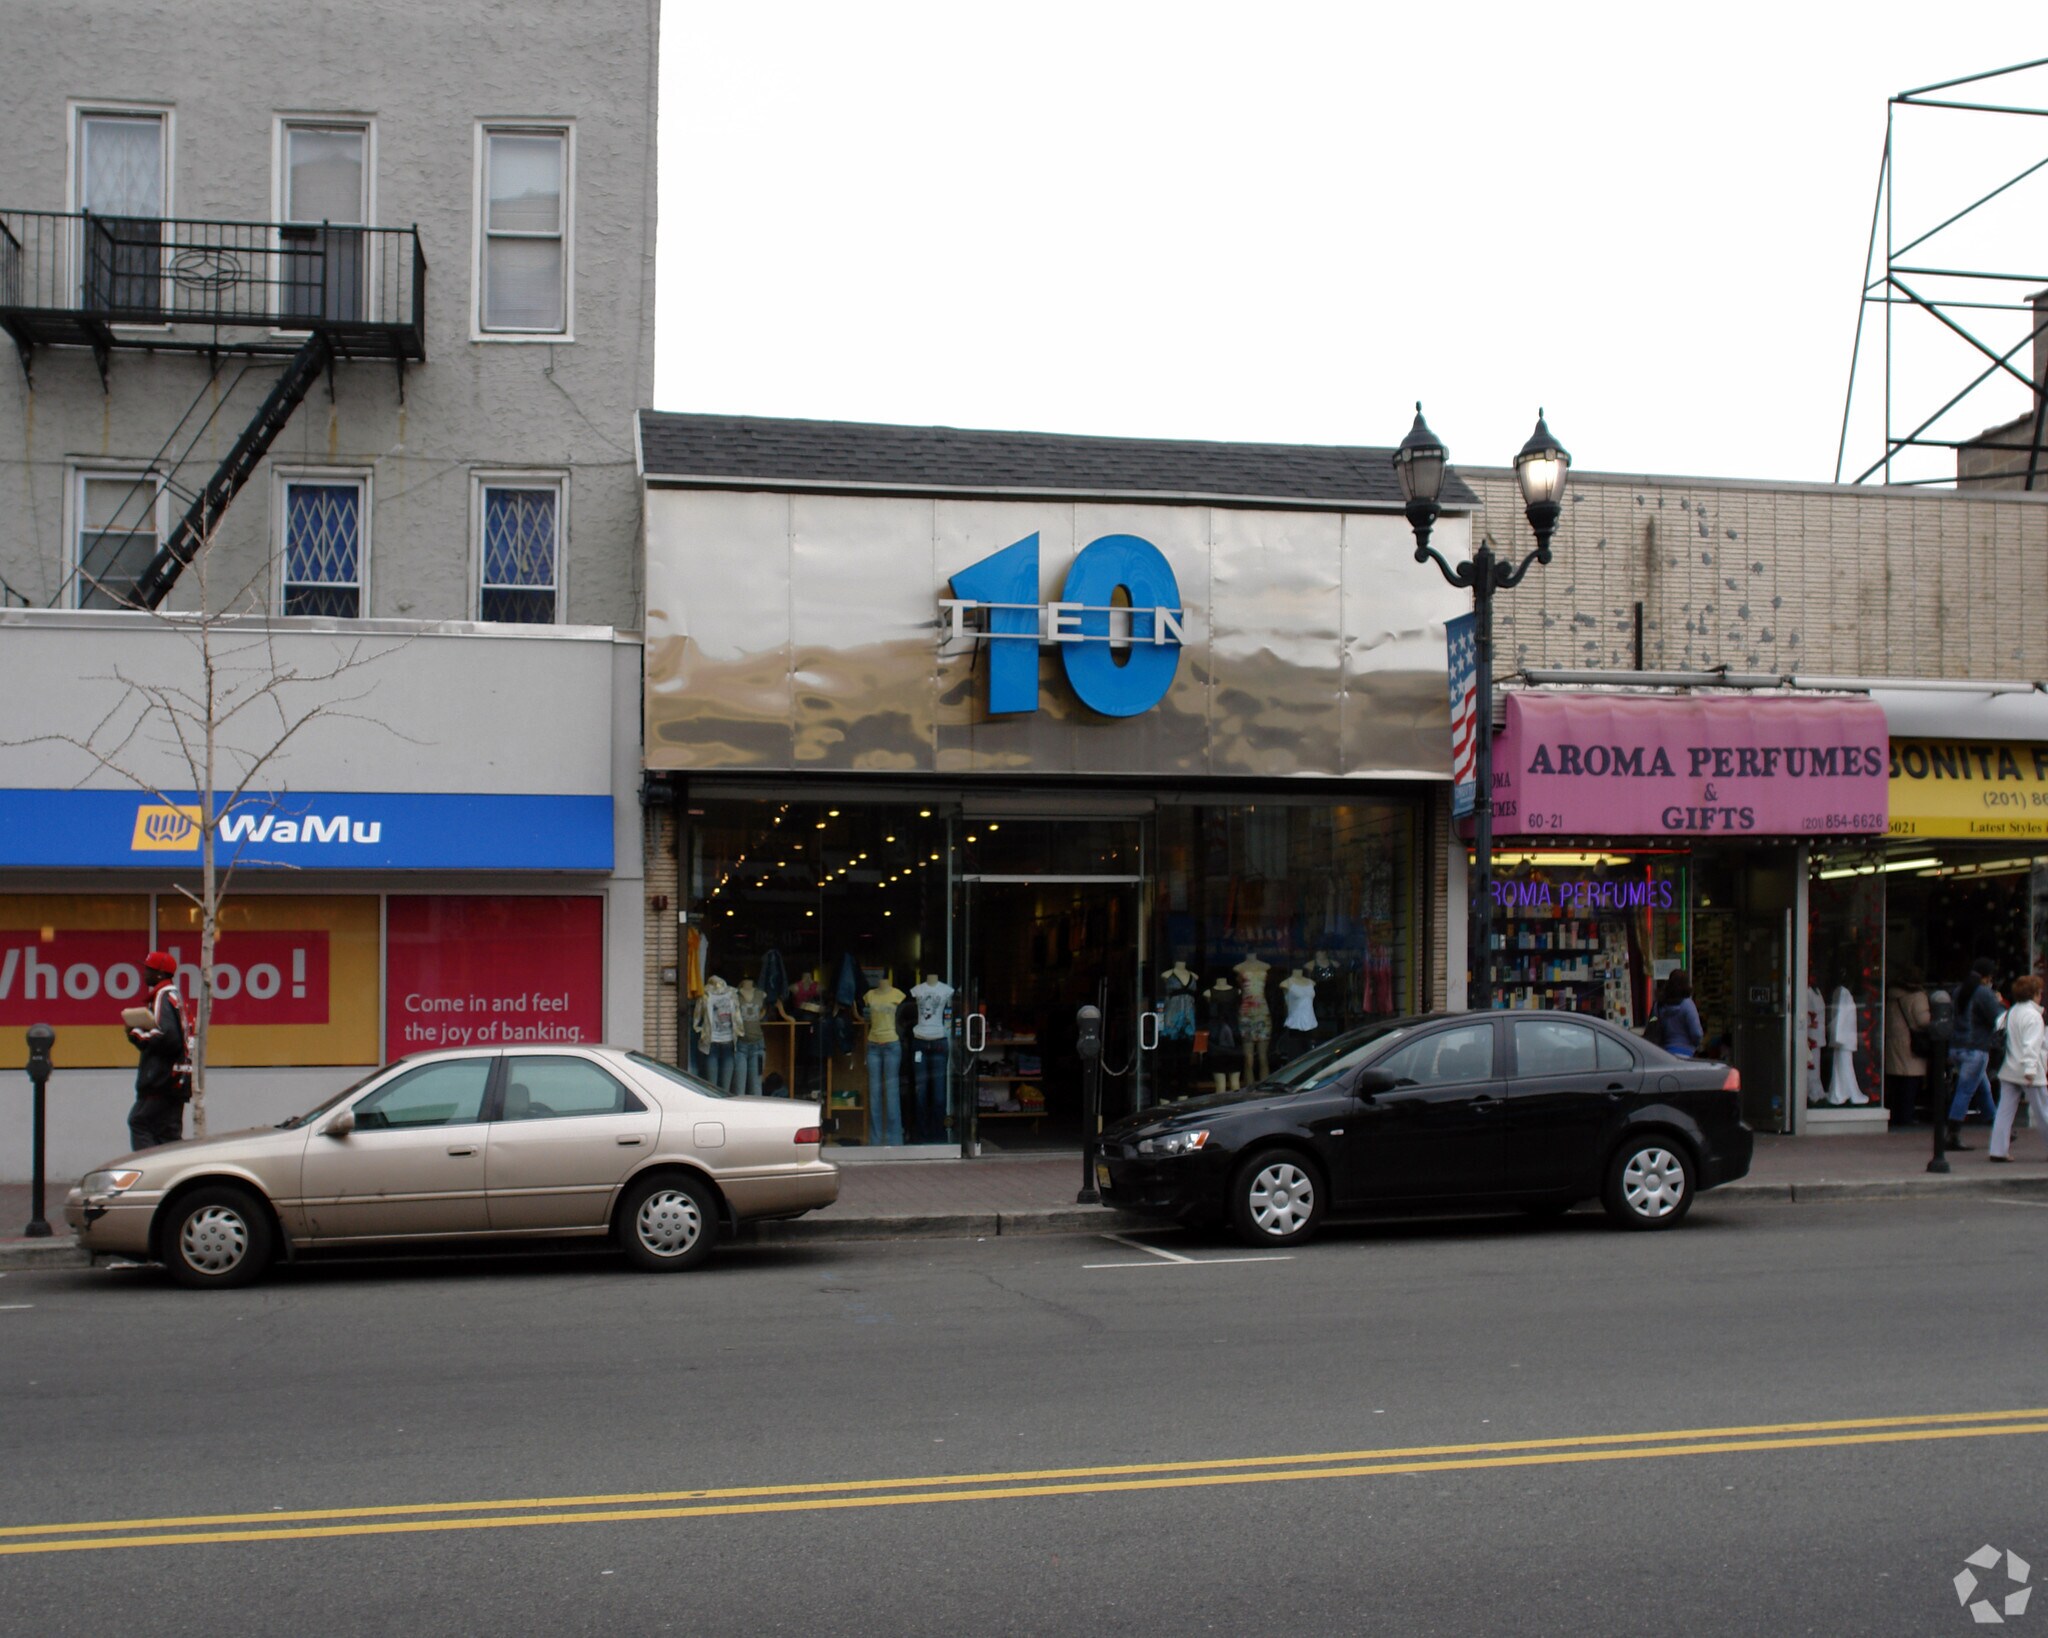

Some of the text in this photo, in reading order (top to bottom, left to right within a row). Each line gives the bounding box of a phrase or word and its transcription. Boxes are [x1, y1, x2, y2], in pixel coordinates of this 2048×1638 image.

[938, 599, 1194, 646] TEN
[949, 530, 1182, 718] 10
[1528, 745, 1882, 778] AROMA PERFUMES
[1703, 783, 1718, 801] &
[1983, 791, 2027, 810] (201)
[217, 815, 381, 843] WaMu
[1528, 814, 1563, 829] 60-21
[1661, 806, 1755, 830] GIFTS
[1801, 813, 1883, 830] (201) 854-6626
[1971, 821, 2005, 834] Latest
[2009, 821, 2042, 836] Styles
[1472, 880, 1672, 909] ROMA PERFUMES
[404, 992, 569, 1012] Come in and feel
[404, 1021, 585, 1045] the joy of banking.
